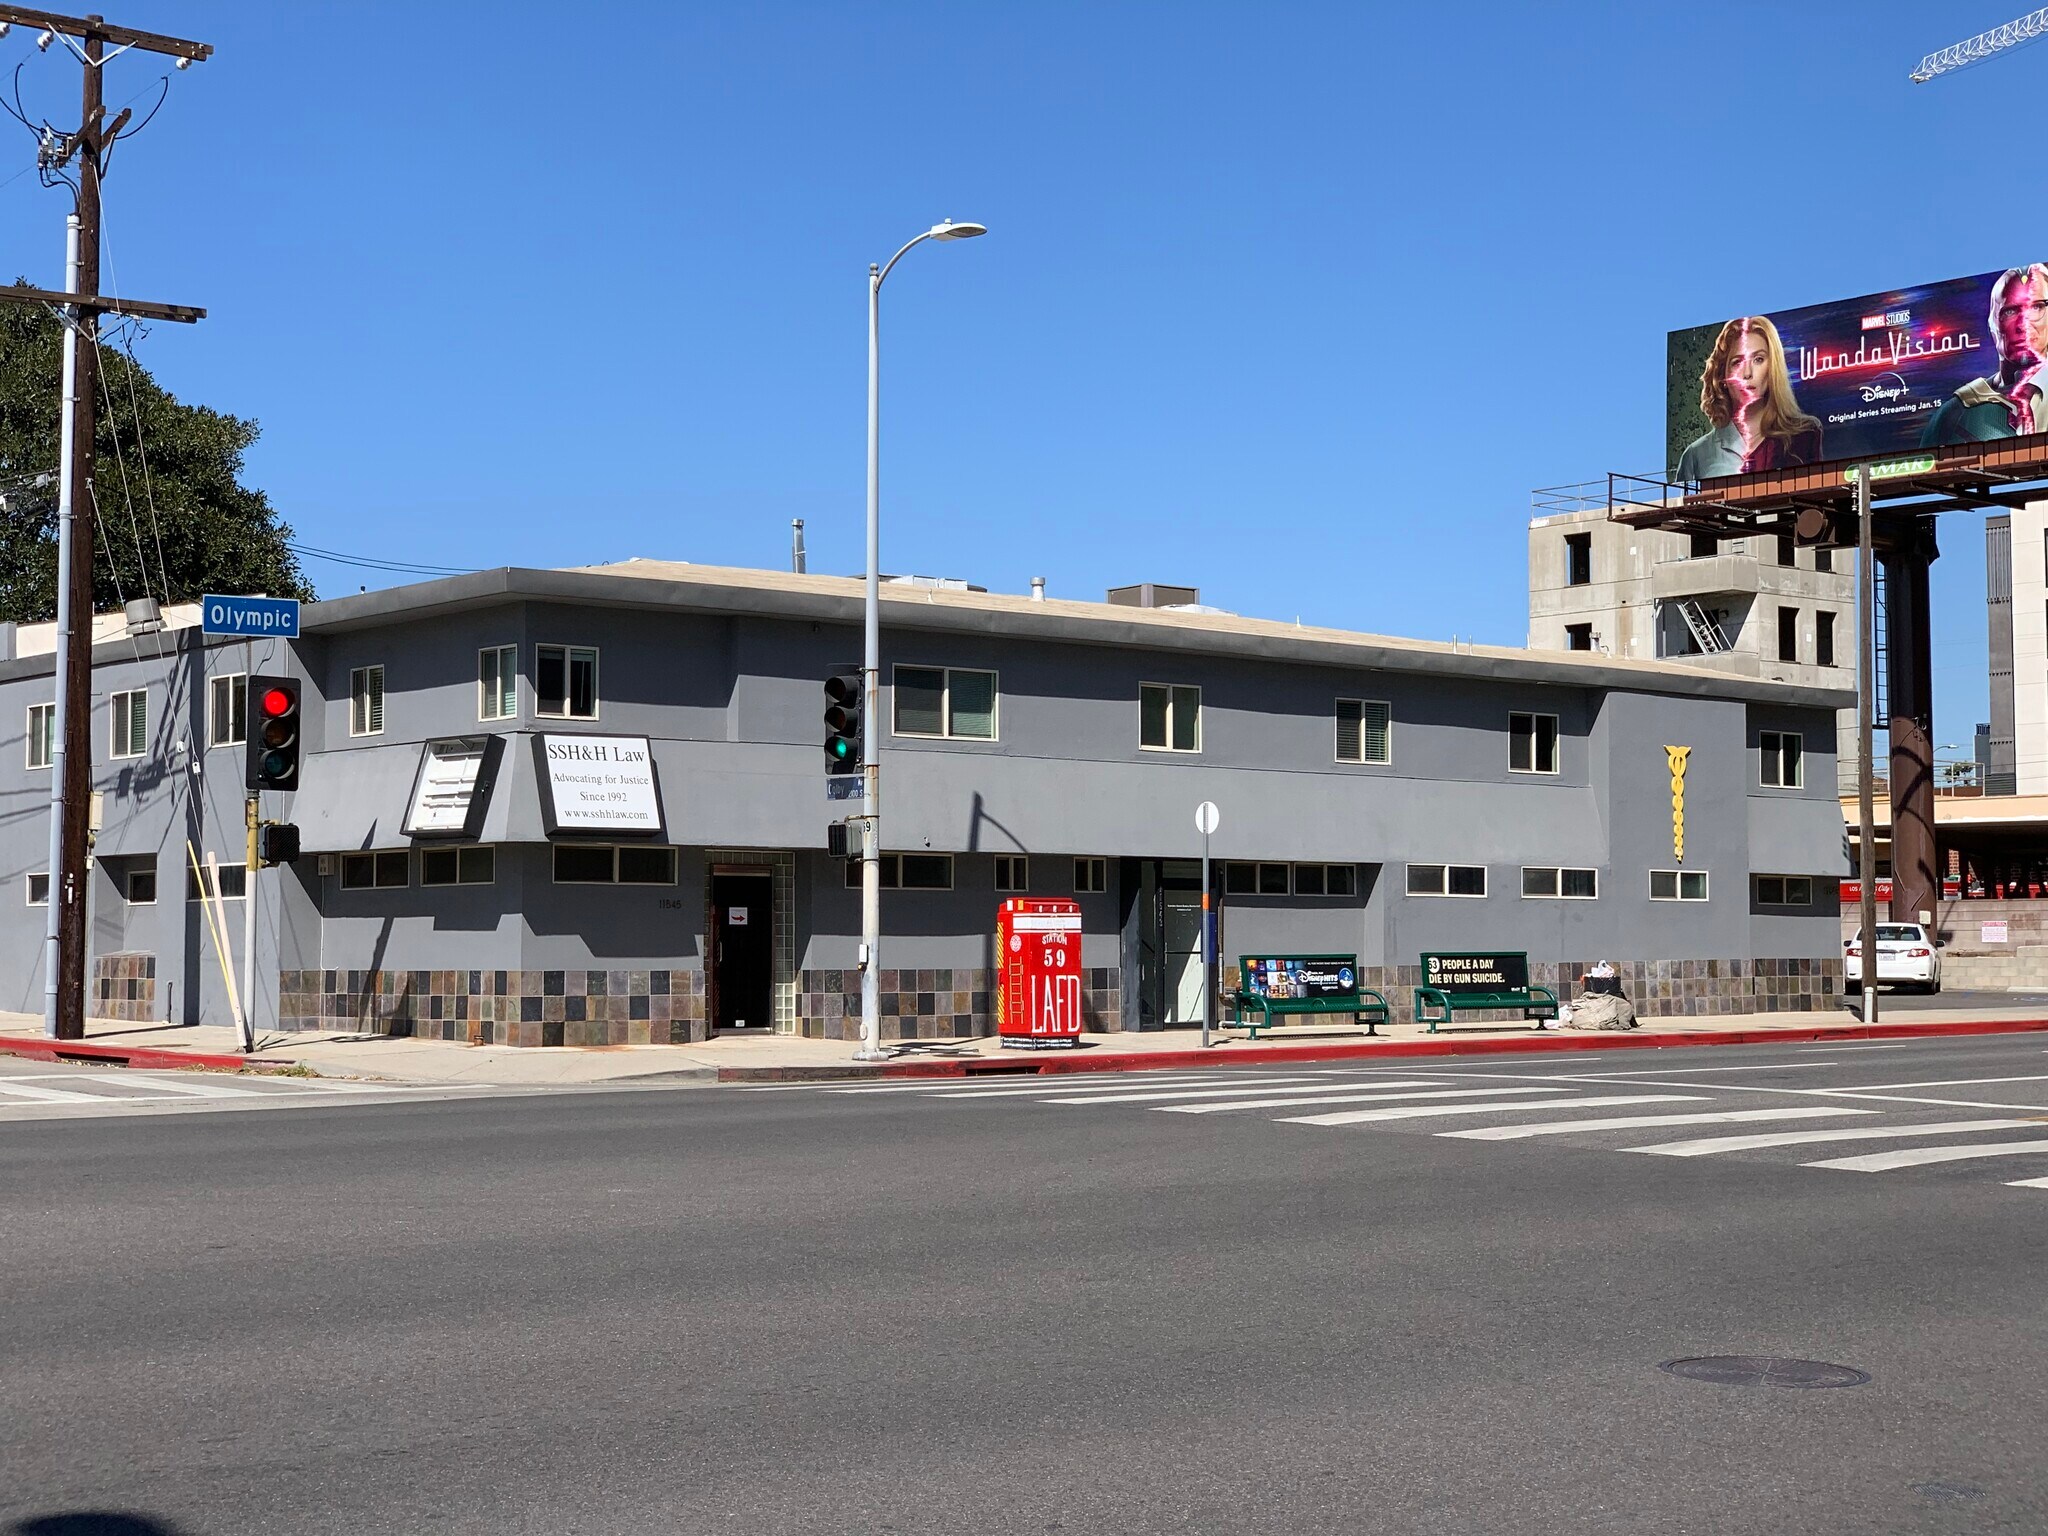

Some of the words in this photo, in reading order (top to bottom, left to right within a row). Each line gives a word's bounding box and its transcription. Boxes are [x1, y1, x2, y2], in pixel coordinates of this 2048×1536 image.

[1862, 315, 1885, 329] MARVEL
[1886, 311, 1910, 326] STUDIOS
[1800, 331, 1980, 381] WandaVision
[1859, 385, 1909, 402] Disney+
[1828, 411, 1856, 423] Original
[1858, 408, 1879, 419] Series
[1880, 403, 1916, 415] Streaming
[211, 605, 291, 631] Olympic
[548, 744, 607, 761] SSH&H
[613, 747, 645, 762] Law
[553, 773, 602, 785] Advocating
[605, 774, 617, 784] for
[620, 775, 649, 785] Justice
[580, 791, 605, 801] Since
[607, 792, 627, 802] 1992
[564, 810, 649, 820] www.sshhlaw.com
[1877, 885, 1890, 894] City
[1041, 932, 1068, 946] STATION
[1043, 948, 1066, 967] 59
[1442, 959, 1471, 969] PEOPLE
[1472, 959, 1479, 969] A
[1480, 959, 1494, 969] DAY
[1324, 974, 1338, 982] HITS
[1428, 973, 1442, 984] DIE
[1443, 973, 1452, 983] BY
[1453, 973, 1471, 983] GUN
[1472, 972, 1505, 983] SUICIDE.
[1031, 975, 1080, 1033] LAFD
